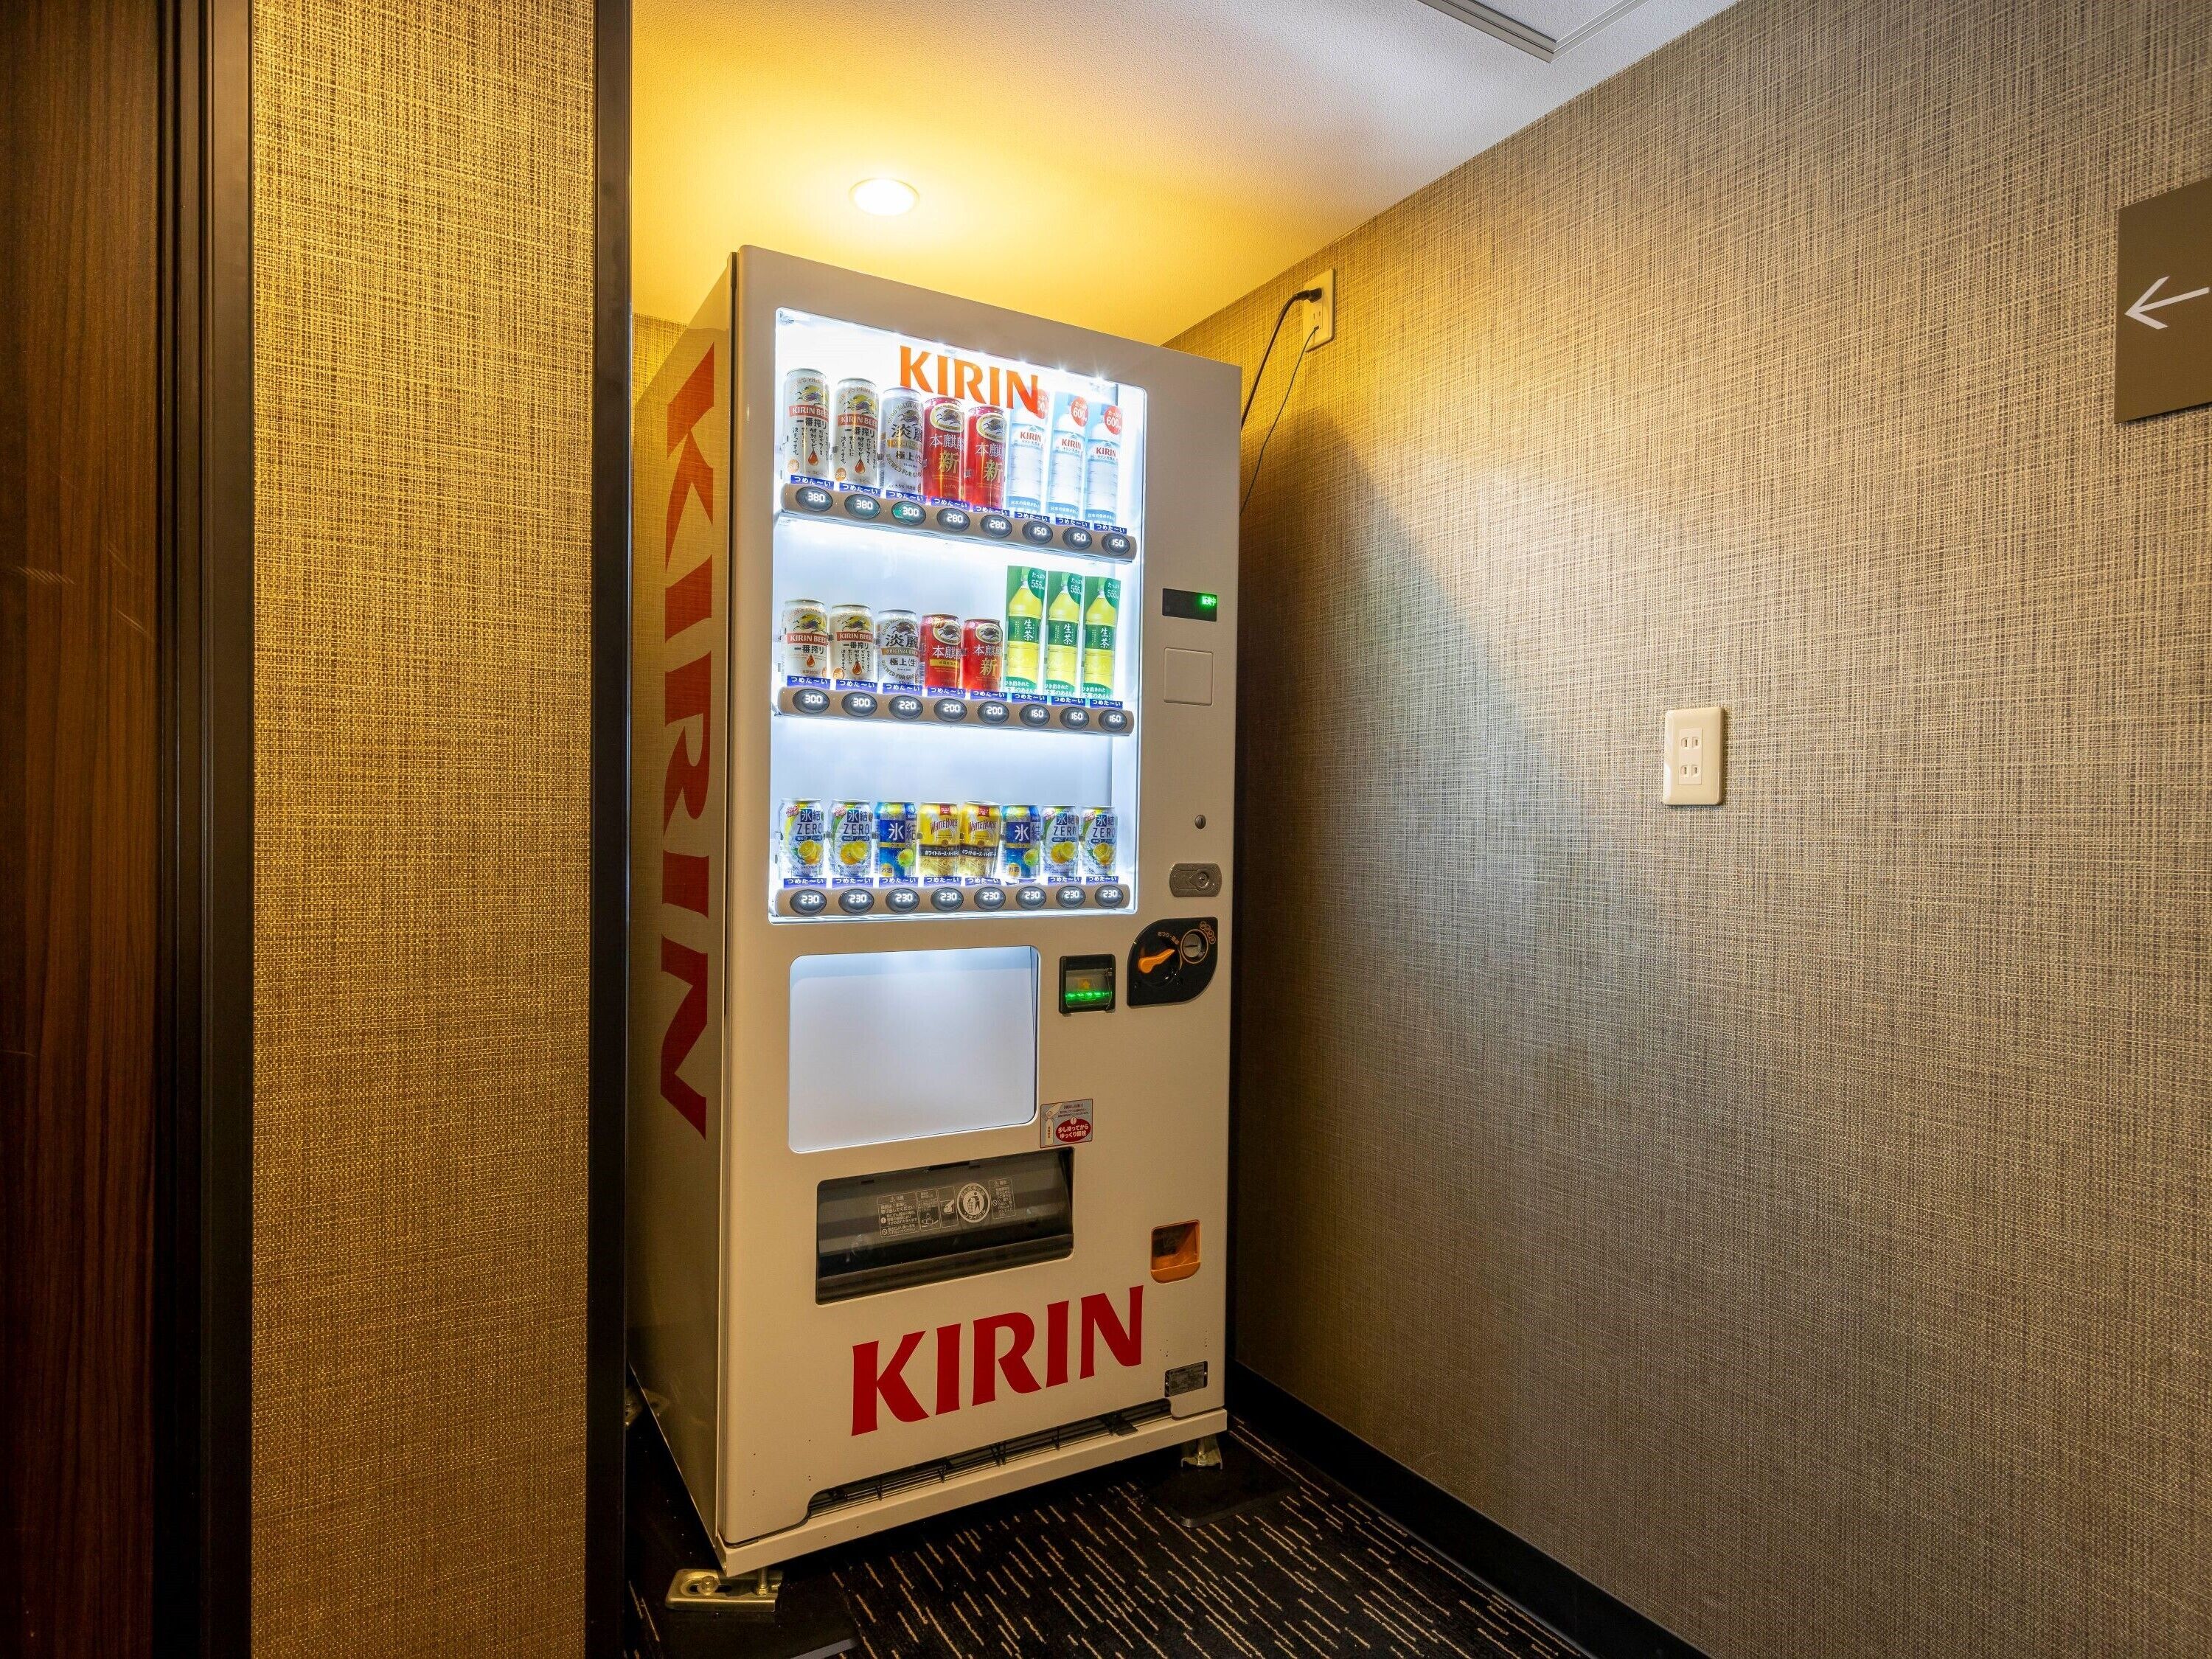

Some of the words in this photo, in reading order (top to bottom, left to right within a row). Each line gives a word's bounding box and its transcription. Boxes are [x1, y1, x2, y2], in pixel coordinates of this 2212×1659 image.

[900, 344, 1039, 415] KIRIN
[792, 406, 815, 415] KIRIN
[841, 416, 863, 425] KIRIN
[1020, 431, 1041, 442] KIRIN
[1062, 438, 1082, 450] KIRIN
[1096, 447, 1116, 457] KIRIN
[807, 493, 827, 503] 380
[855, 499, 873, 510] 380
[902, 506, 919, 517] 300
[947, 513, 964, 524] 280
[990, 520, 1006, 529] 280
[1033, 526, 1047, 536] 150
[1073, 532, 1087, 541] 150
[1112, 538, 1124, 547] 150
[1023, 619, 1034, 641] 生茶
[1063, 623, 1073, 645] 生茶
[1099, 627, 1110, 649] 生茶
[794, 644, 824, 655] 一番搾り
[843, 641, 869, 650] 一番搾り
[980, 658, 997, 677] 新
[805, 695, 823, 704] 300
[853, 698, 870, 707] 300
[899, 701, 917, 710] 220
[944, 704, 961, 712] 200
[987, 707, 1003, 715] 200
[1032, 709, 1044, 718] 160
[1071, 712, 1083, 720] 160
[660, 342, 714, 1140] KIRIN
[801, 810, 821, 821] 氷結
[847, 810, 868, 822] 氷結
[797, 823, 822, 835] ZERO
[844, 824, 869, 835] ZERO
[888, 822, 917, 841] 氷結
[930, 819, 945, 835] WHITE
[1053, 826, 1077, 836] ZERO
[1093, 827, 1116, 838] ZERO
[801, 895, 819, 904] 230
[849, 894, 866, 903] 230
[895, 894, 913, 902] 230
[940, 893, 957, 901] 230
[984, 892, 999, 900] 230
[1025, 891, 1040, 900] 230
[1064, 891, 1079, 899] 230
[1057, 1124, 1089, 1134] 少し待ってから
[851, 1284, 1144, 1437] KIRIN
